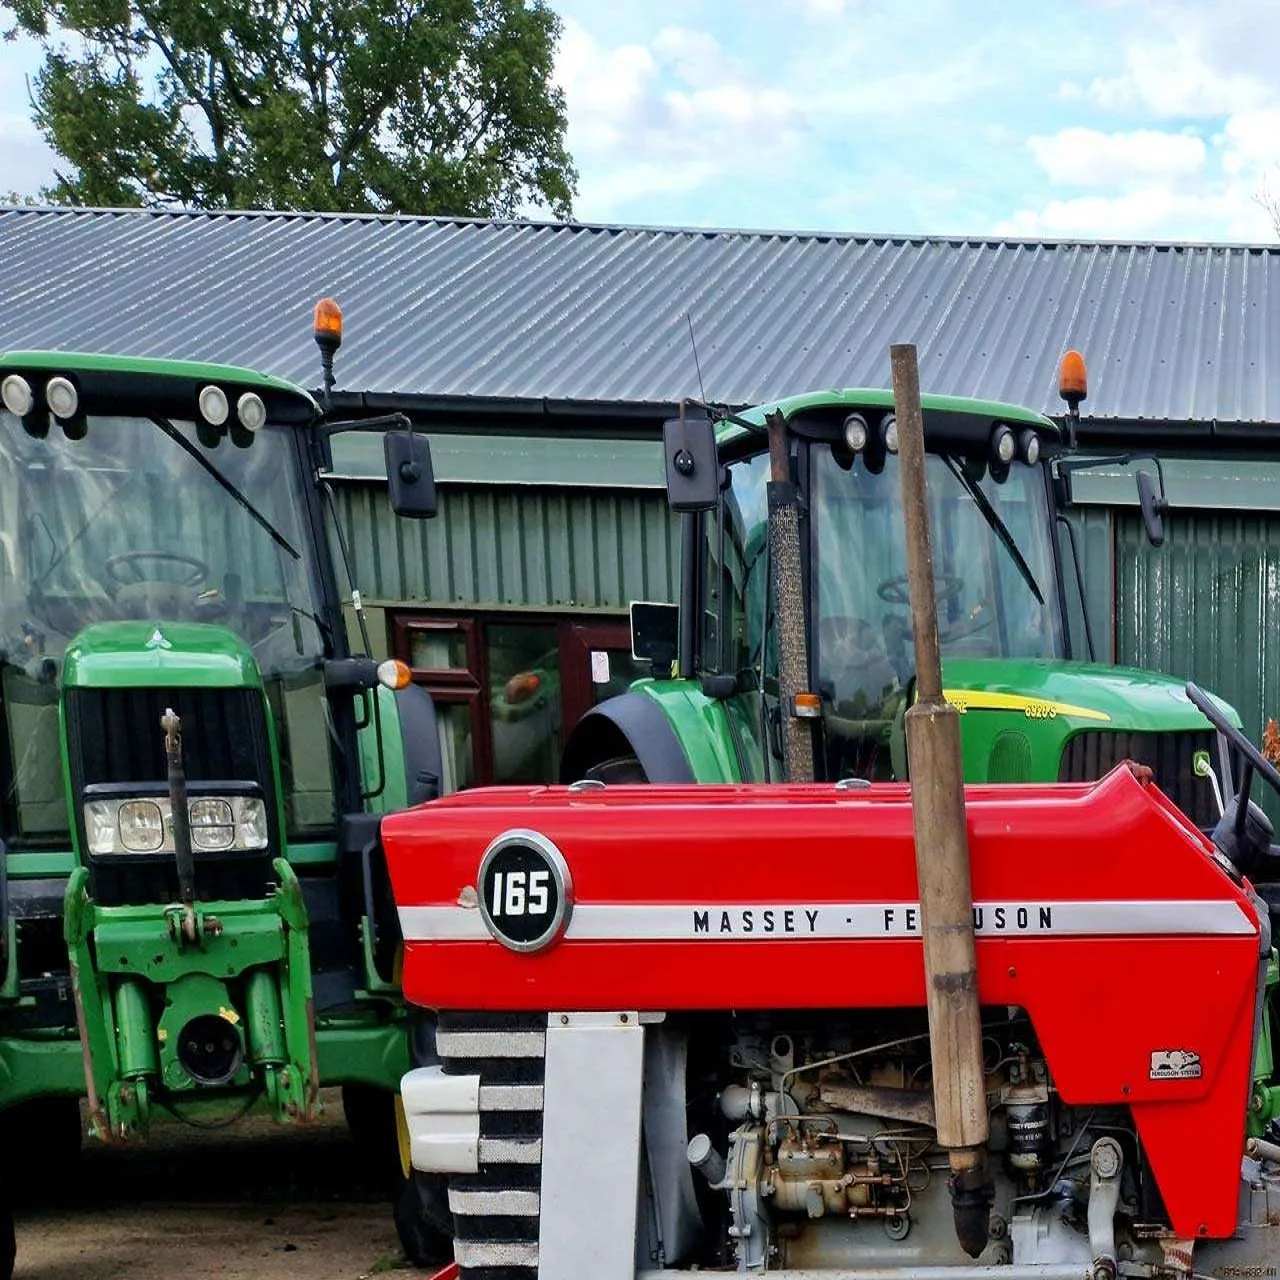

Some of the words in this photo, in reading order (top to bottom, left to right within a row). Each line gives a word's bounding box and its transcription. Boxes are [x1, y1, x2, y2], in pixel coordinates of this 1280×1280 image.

[493, 871, 549, 917] 165
[693, 909, 820, 933] MASSEY
[884, 907, 1052, 931] FEUSON
